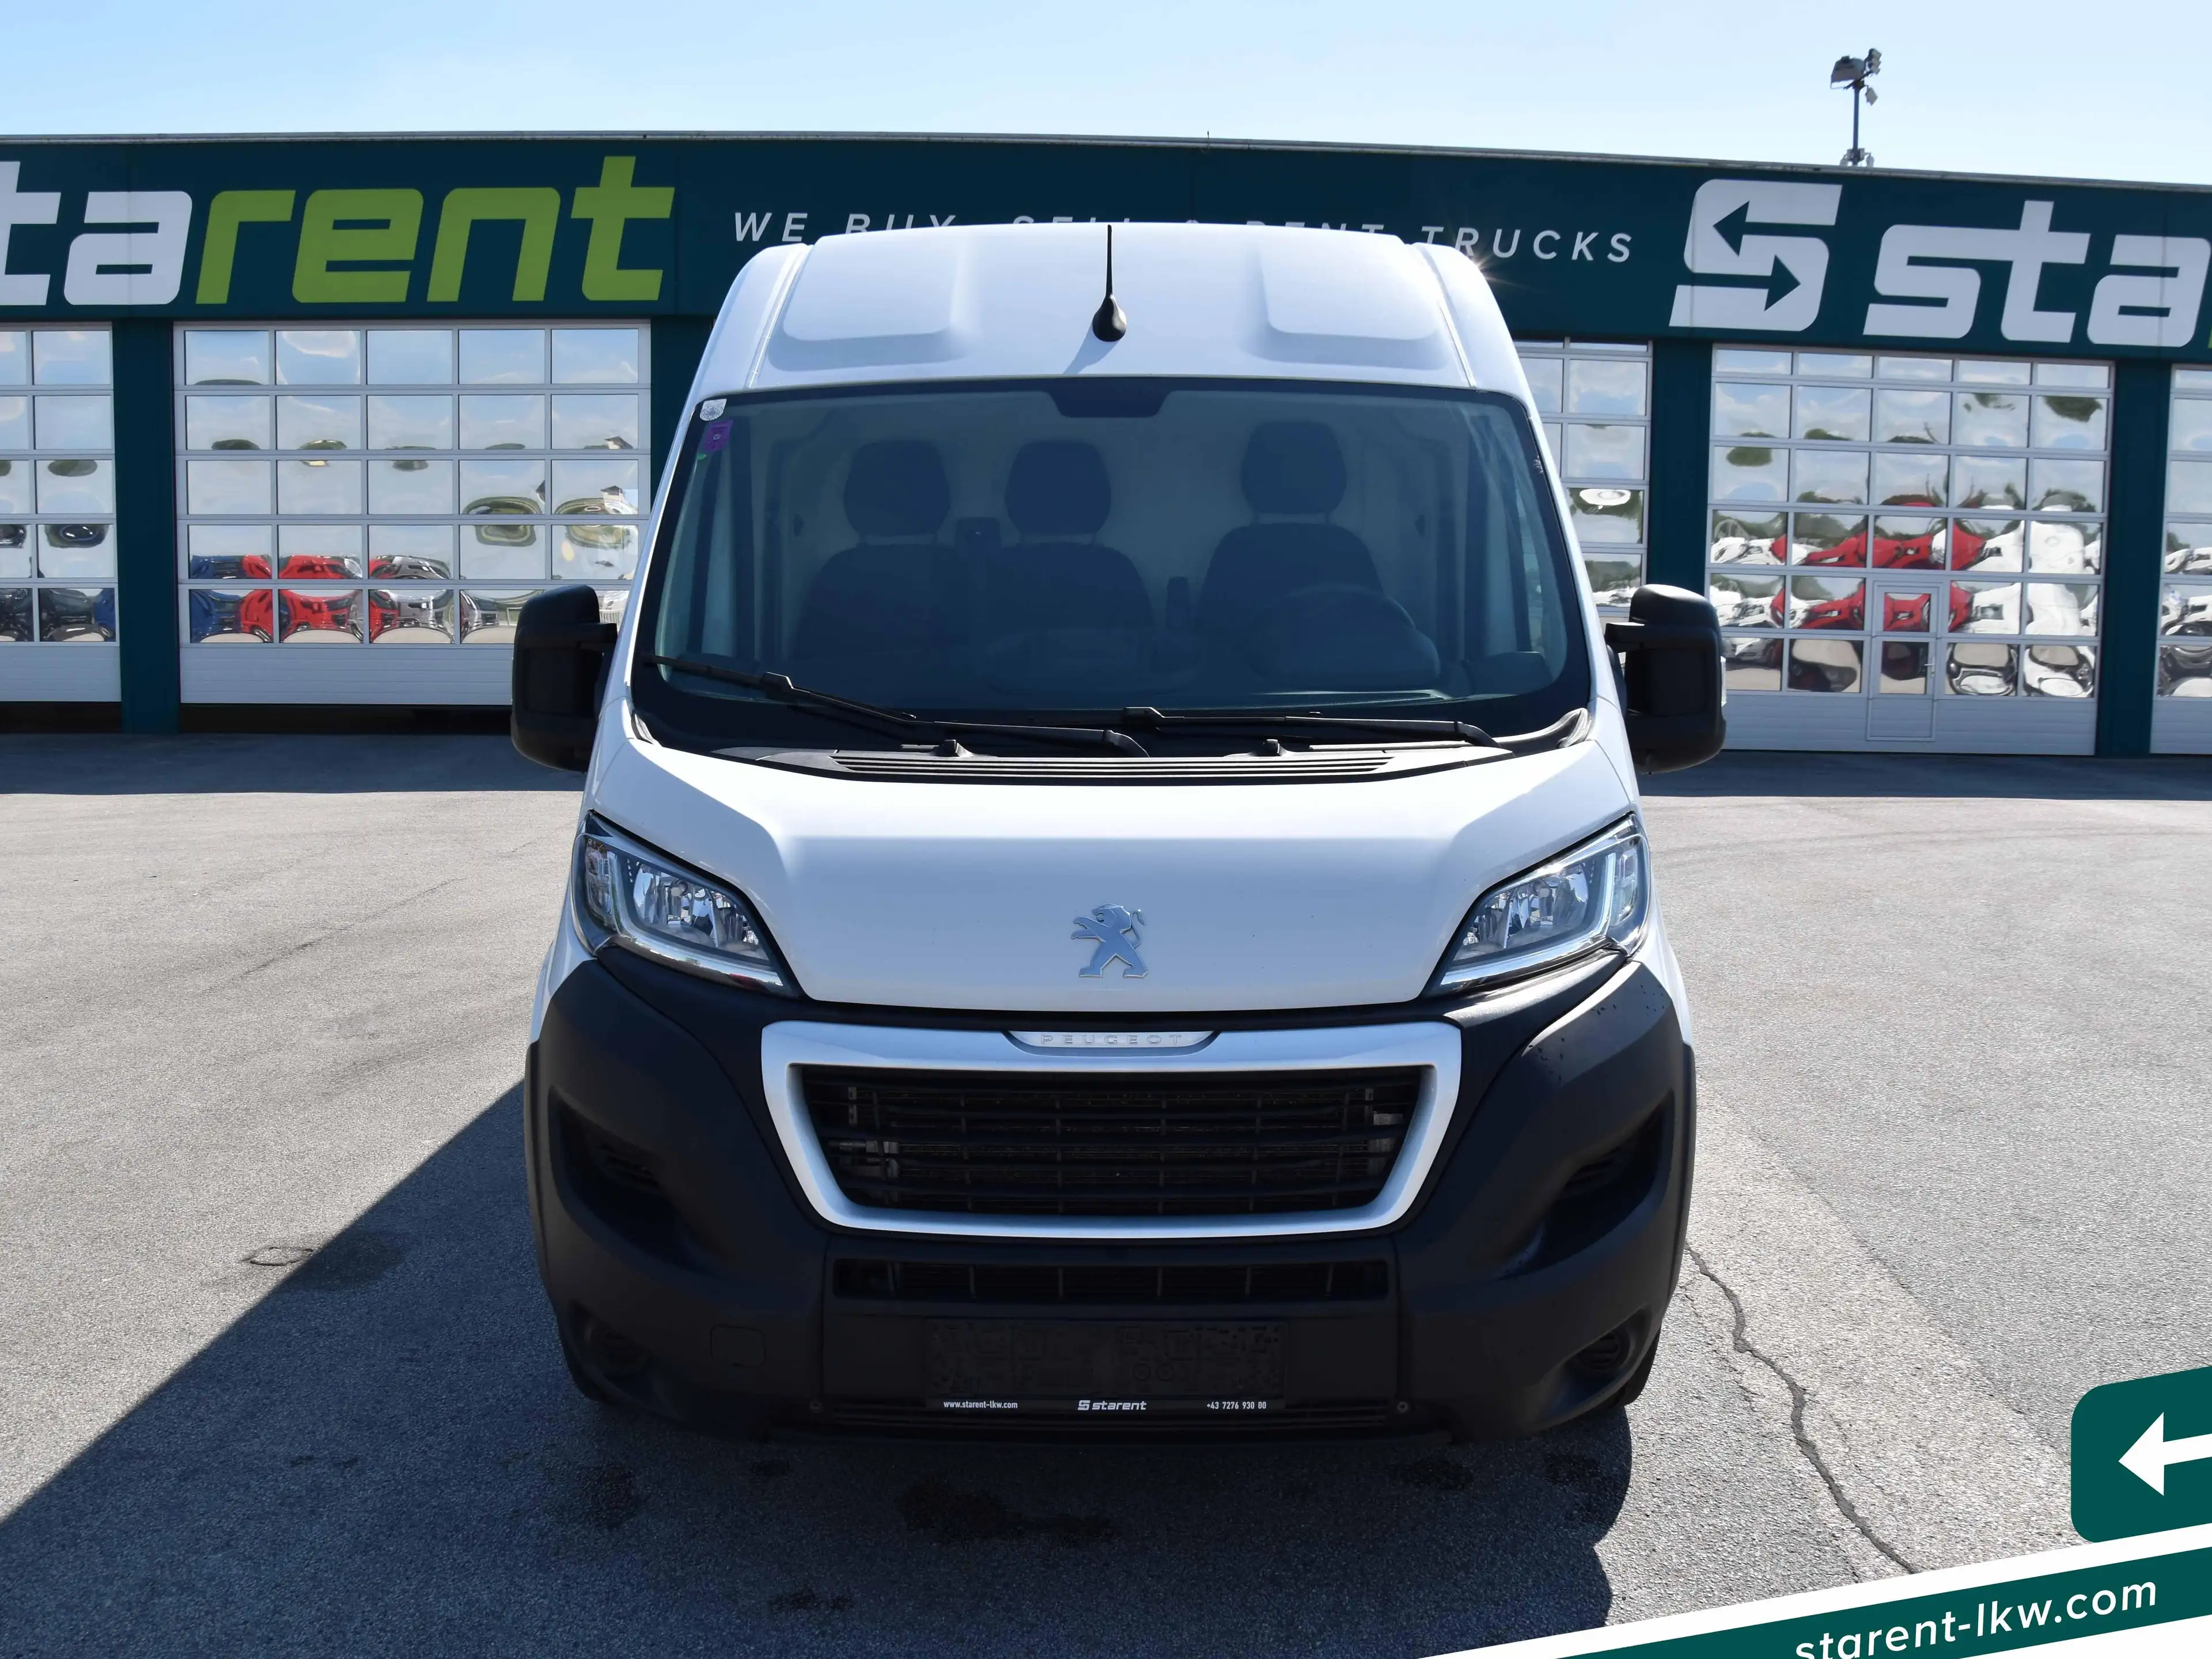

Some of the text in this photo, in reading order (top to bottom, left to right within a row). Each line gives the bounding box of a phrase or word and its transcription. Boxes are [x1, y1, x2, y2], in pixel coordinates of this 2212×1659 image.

[734, 212, 808, 243] WE
[1421, 225, 1633, 263] TRUCKS
[1862, 200, 2212, 348] sta
[1040, 1034, 1181, 1045] PEUGEOT
[943, 1400, 1018, 1409] www.starent-lkw.com
[1092, 1400, 1147, 1410] starent
[1222, 1401, 1239, 1410] 7276
[1242, 1401, 1255, 1410] 930
[1257, 1401, 1266, 1410] 00
